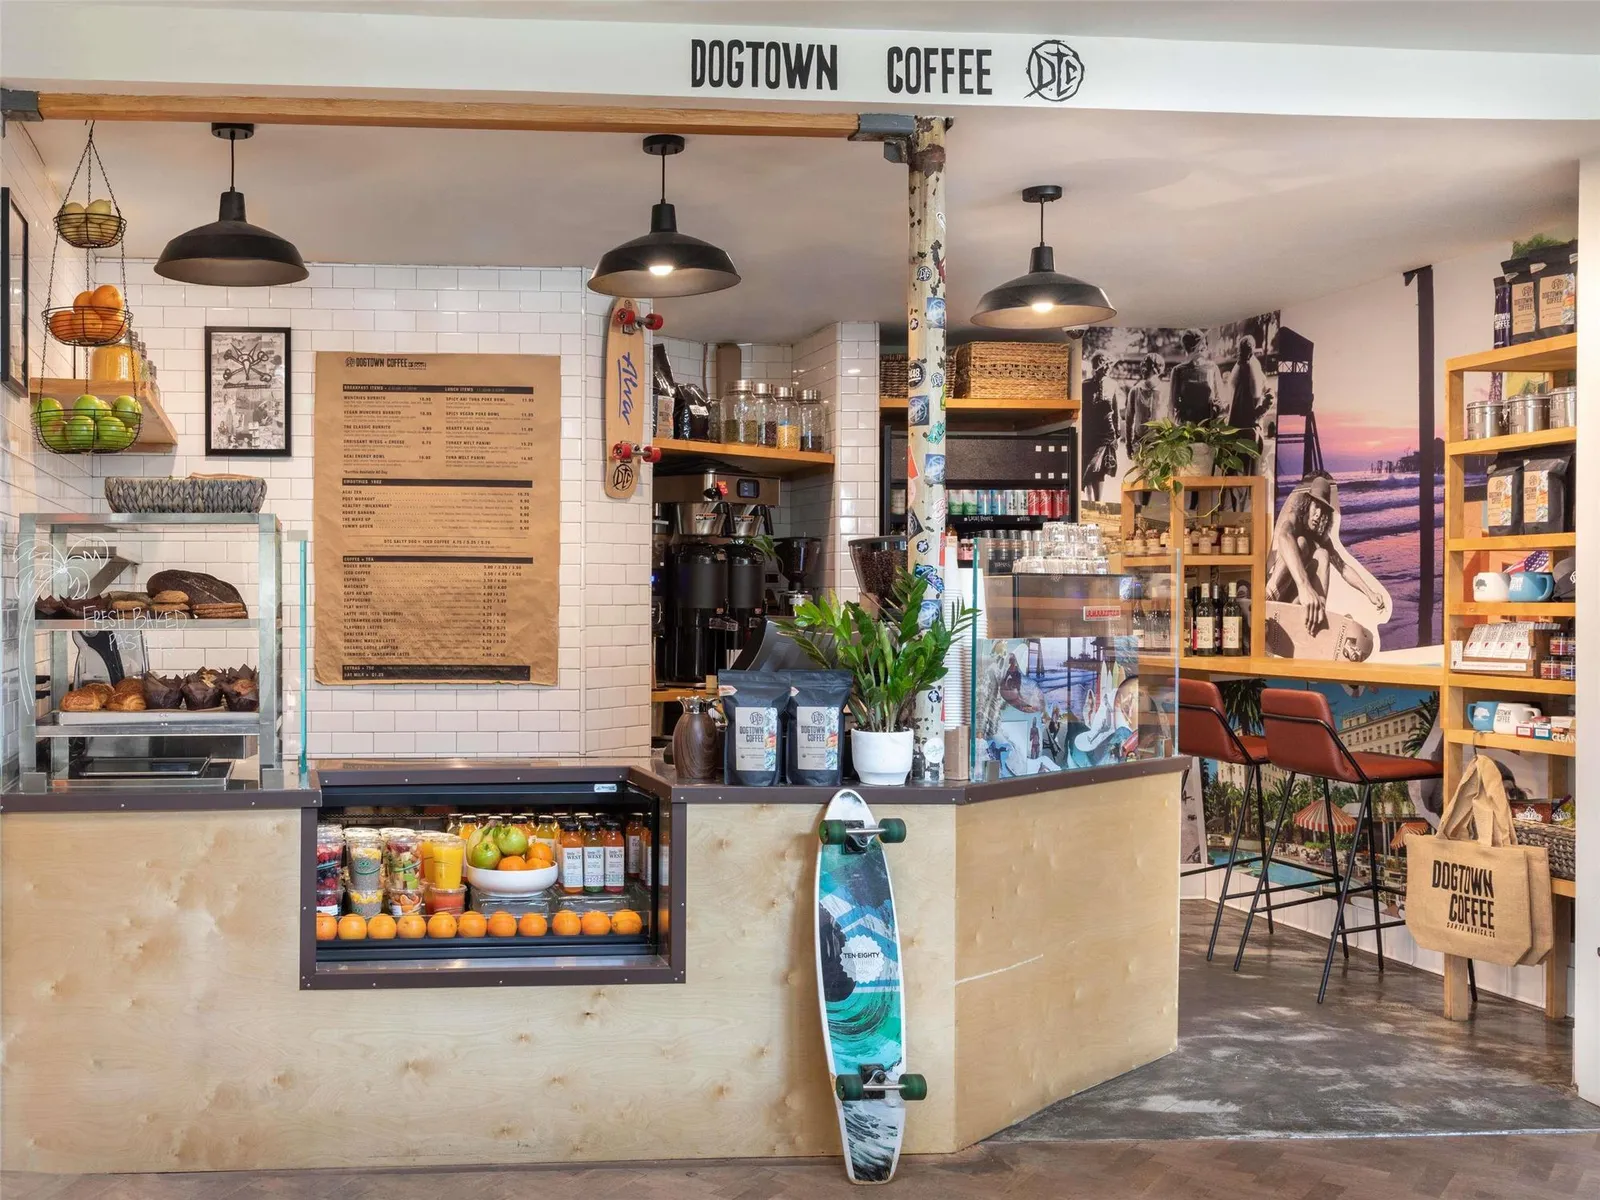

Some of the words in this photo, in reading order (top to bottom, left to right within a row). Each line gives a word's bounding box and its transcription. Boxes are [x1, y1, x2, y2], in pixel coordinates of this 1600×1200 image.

[691, 38, 838, 90] DOGTOWN
[888, 45, 993, 94] COFFEE
[1542, 291, 1563, 299] DOGTOWN
[1514, 298, 1533, 306] DOGTOWN
[1546, 297, 1562, 305] COFFEE
[356, 358, 385, 368] DOGTOWN
[387, 359, 408, 368] COFFEE
[84, 605, 126, 630] FRESH
[133, 606, 187, 630] BAKED
[740, 726, 764, 735] DOGTOWN
[801, 725, 826, 735] DOGTOWN
[746, 734, 764, 743] COFFEE
[807, 734, 826, 743] COFFEE
[1432, 859, 1494, 899] DOGTOWN
[1448, 893, 1495, 930] COFFEE
